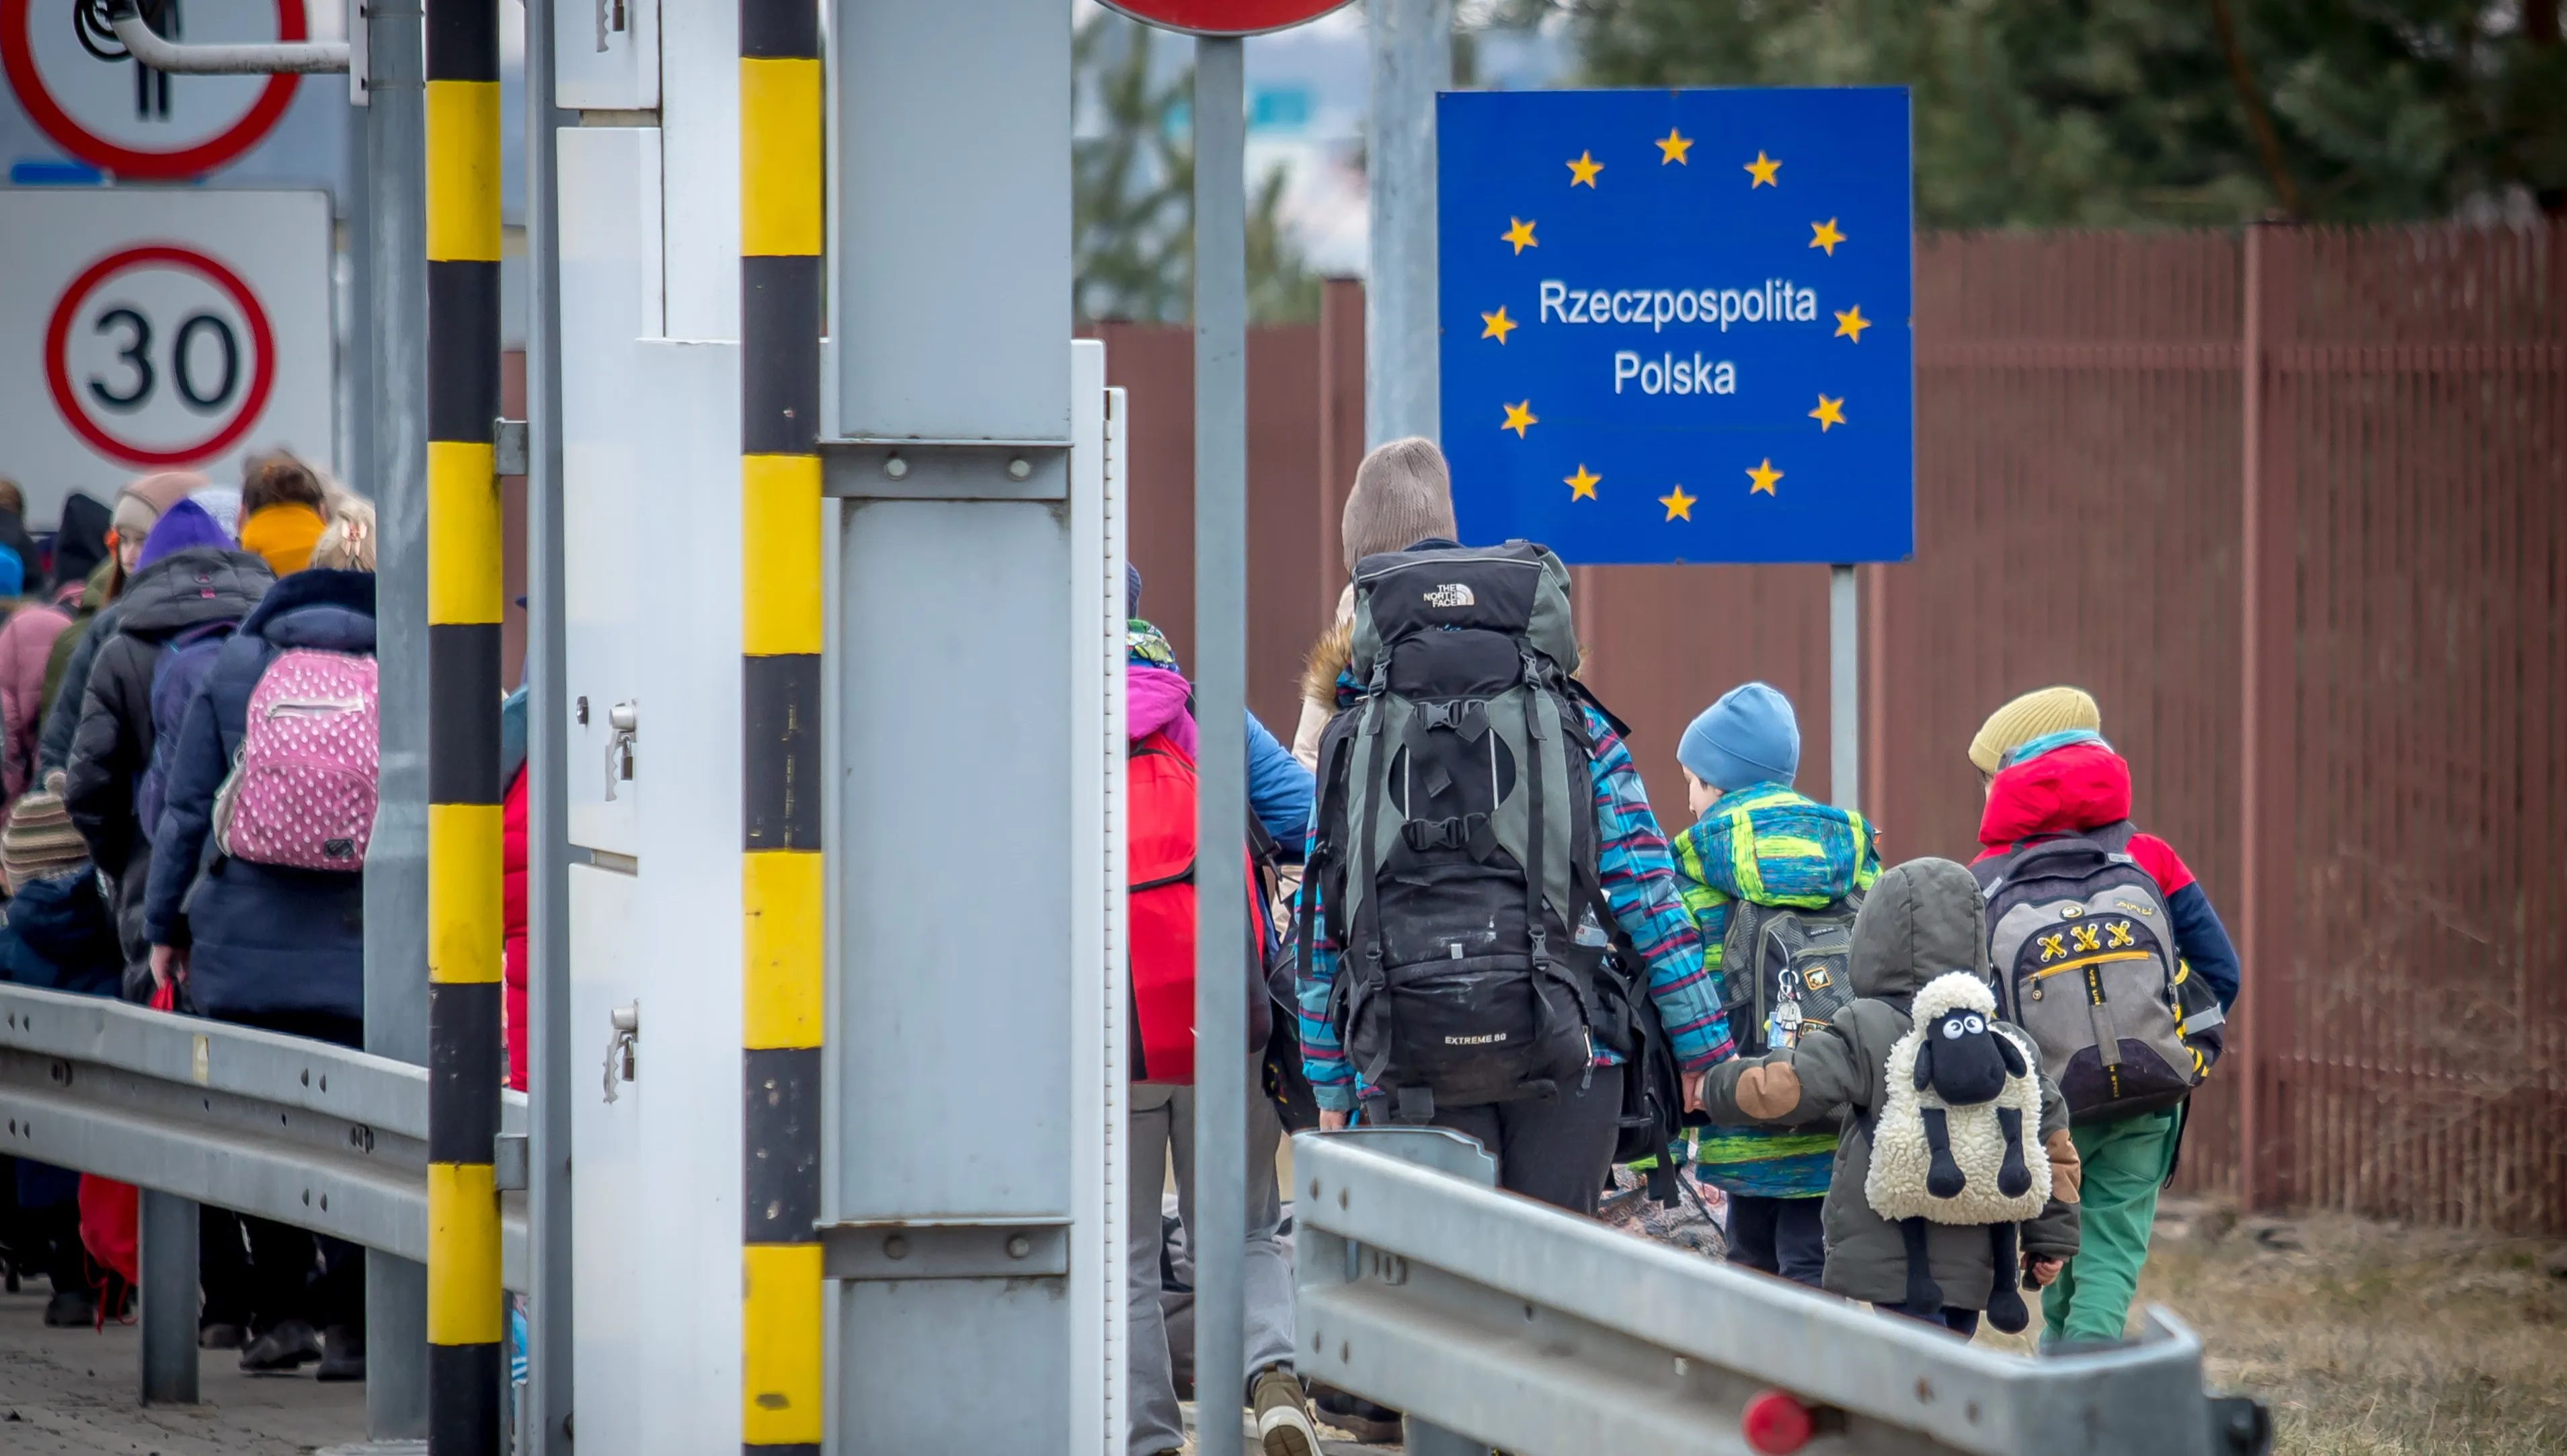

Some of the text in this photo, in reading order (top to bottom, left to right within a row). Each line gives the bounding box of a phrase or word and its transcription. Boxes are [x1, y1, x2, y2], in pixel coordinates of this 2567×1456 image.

[1539, 278, 1817, 333] Rzeczpospolita
[89, 306, 238, 409] 30
[1614, 350, 1737, 395] Polska
[1436, 583, 1457, 593] THE
[1423, 592, 1458, 602] NORTH
[1432, 598, 1458, 608] FACE
[1444, 1034, 1493, 1045] EXTREME
